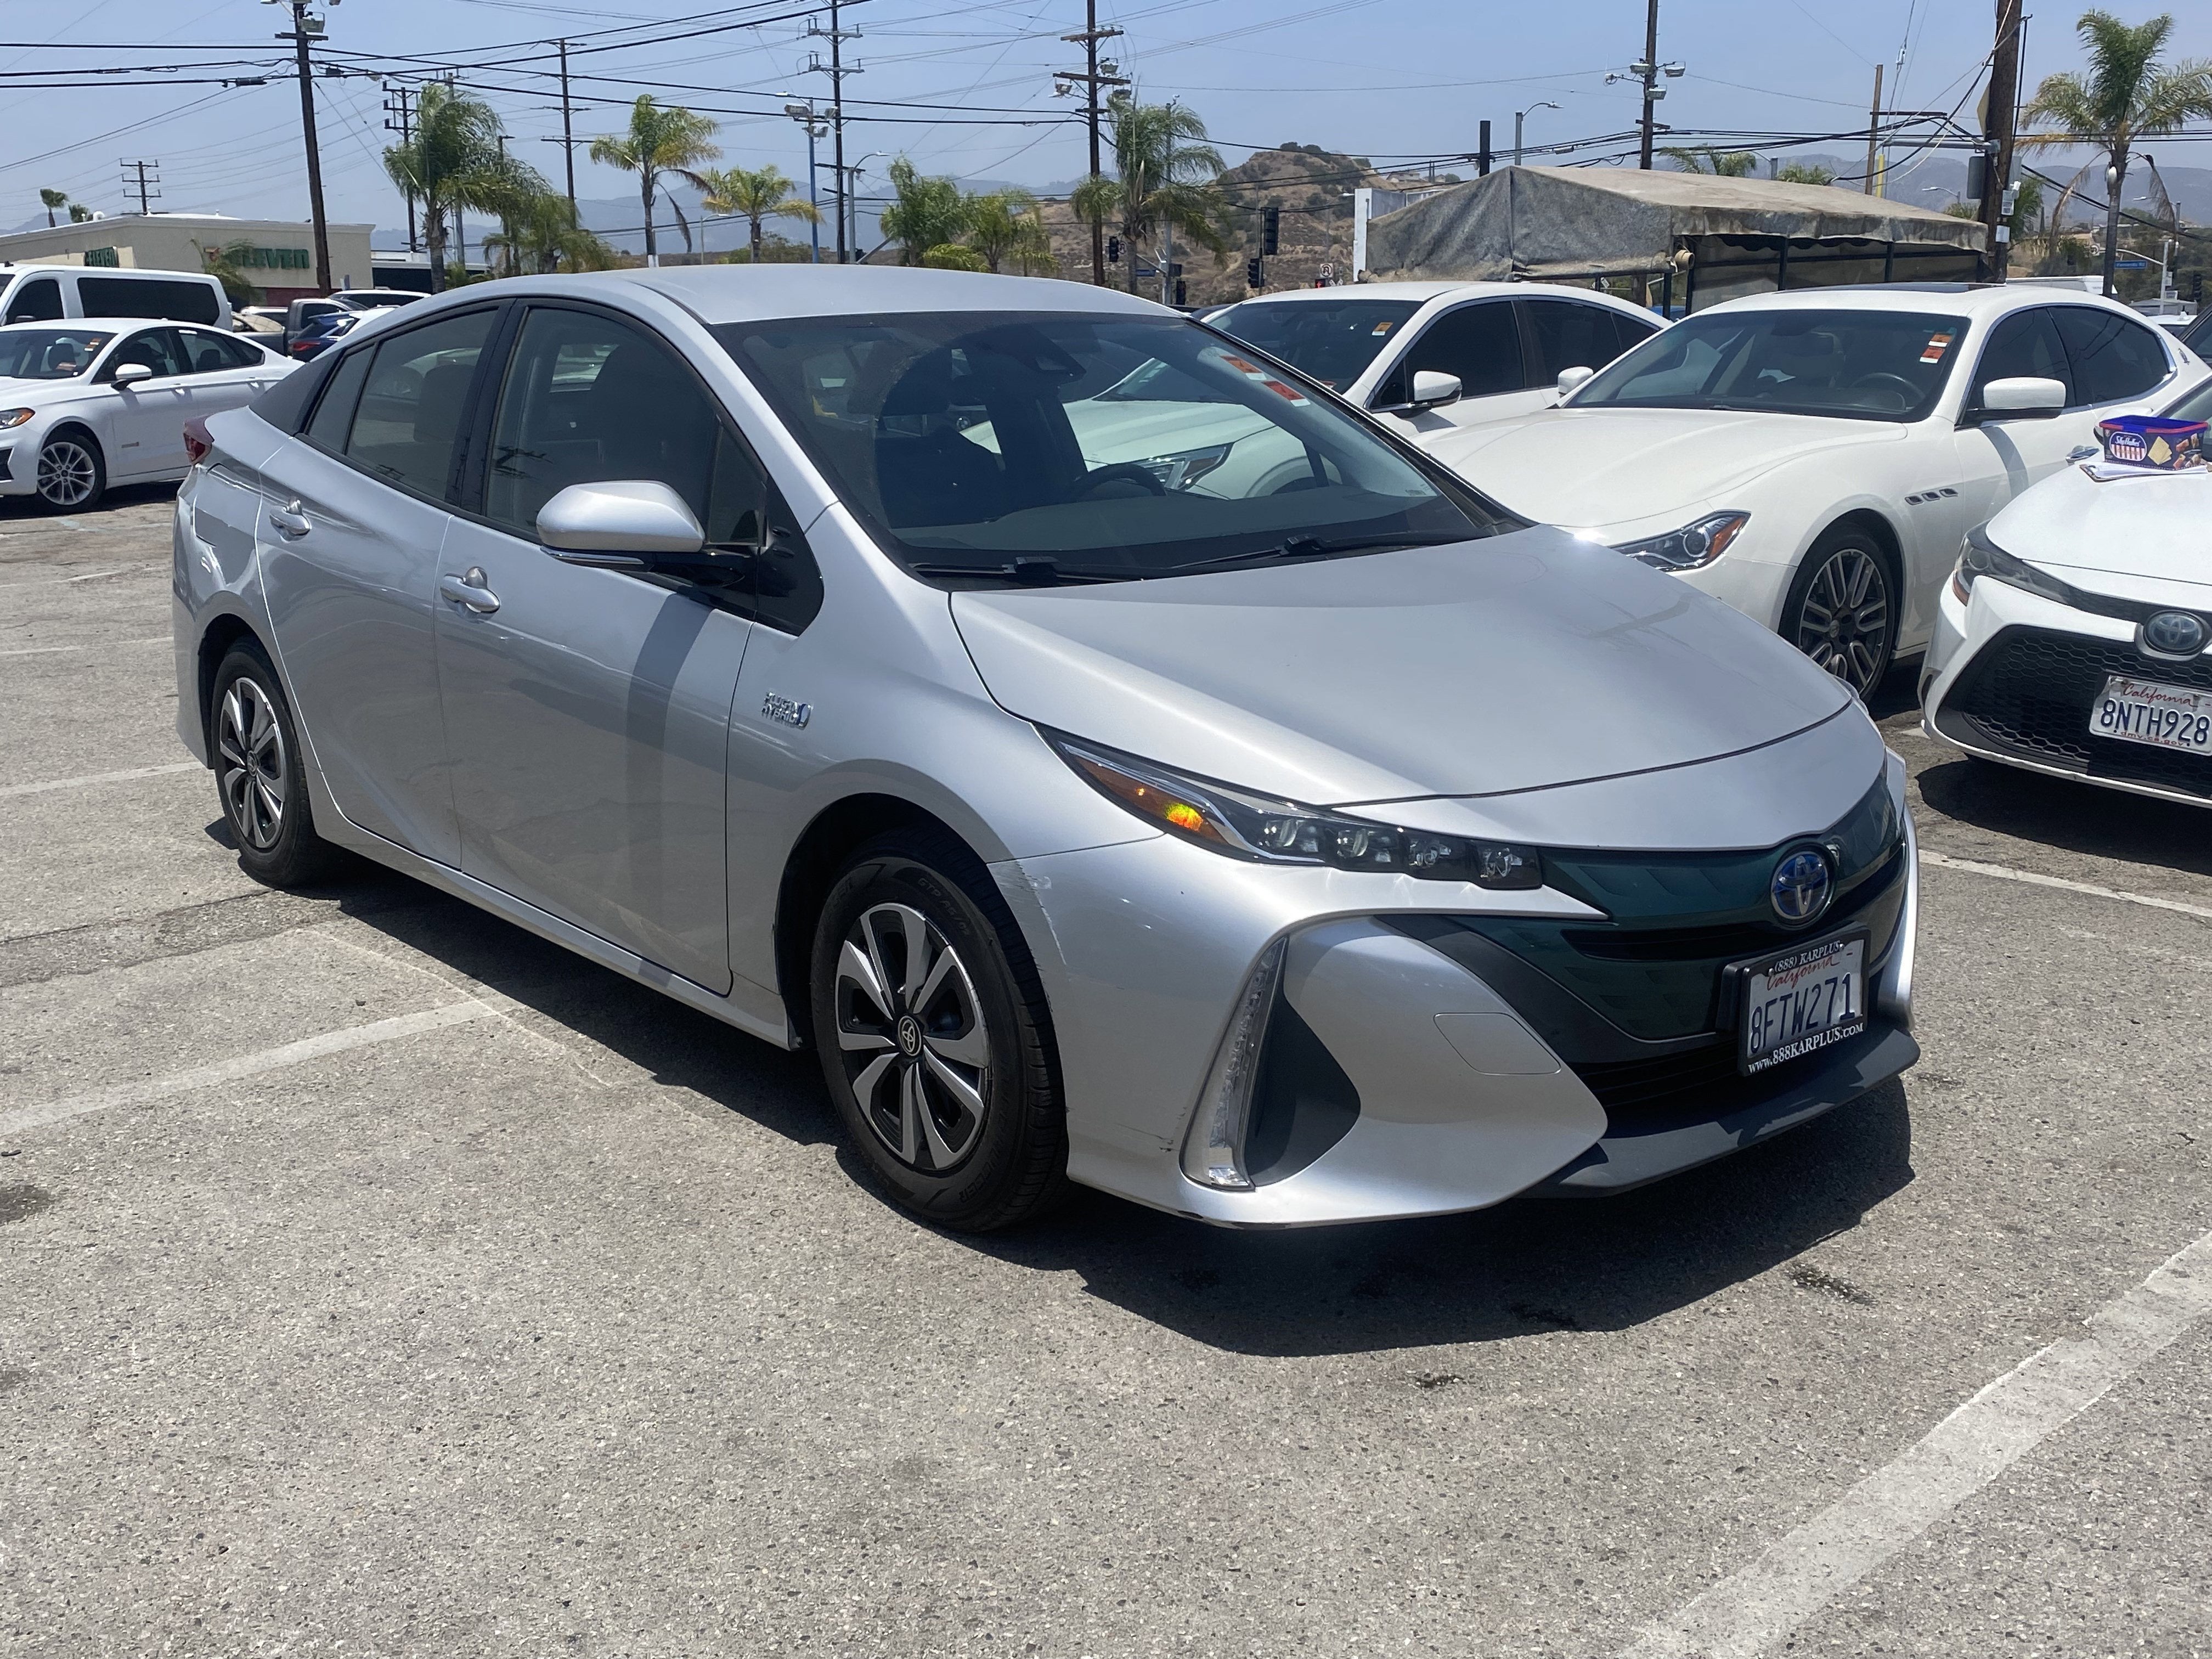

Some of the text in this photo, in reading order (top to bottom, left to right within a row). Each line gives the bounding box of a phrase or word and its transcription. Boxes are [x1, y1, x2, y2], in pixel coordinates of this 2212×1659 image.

[2124, 684, 2198, 708] California
[2101, 698, 2210, 745] 8NTH928
[1767, 956, 1840, 991] California
[1774, 940, 1841, 973] (888) KARPLUS
[1751, 973, 1855, 1054] 8FTW271
